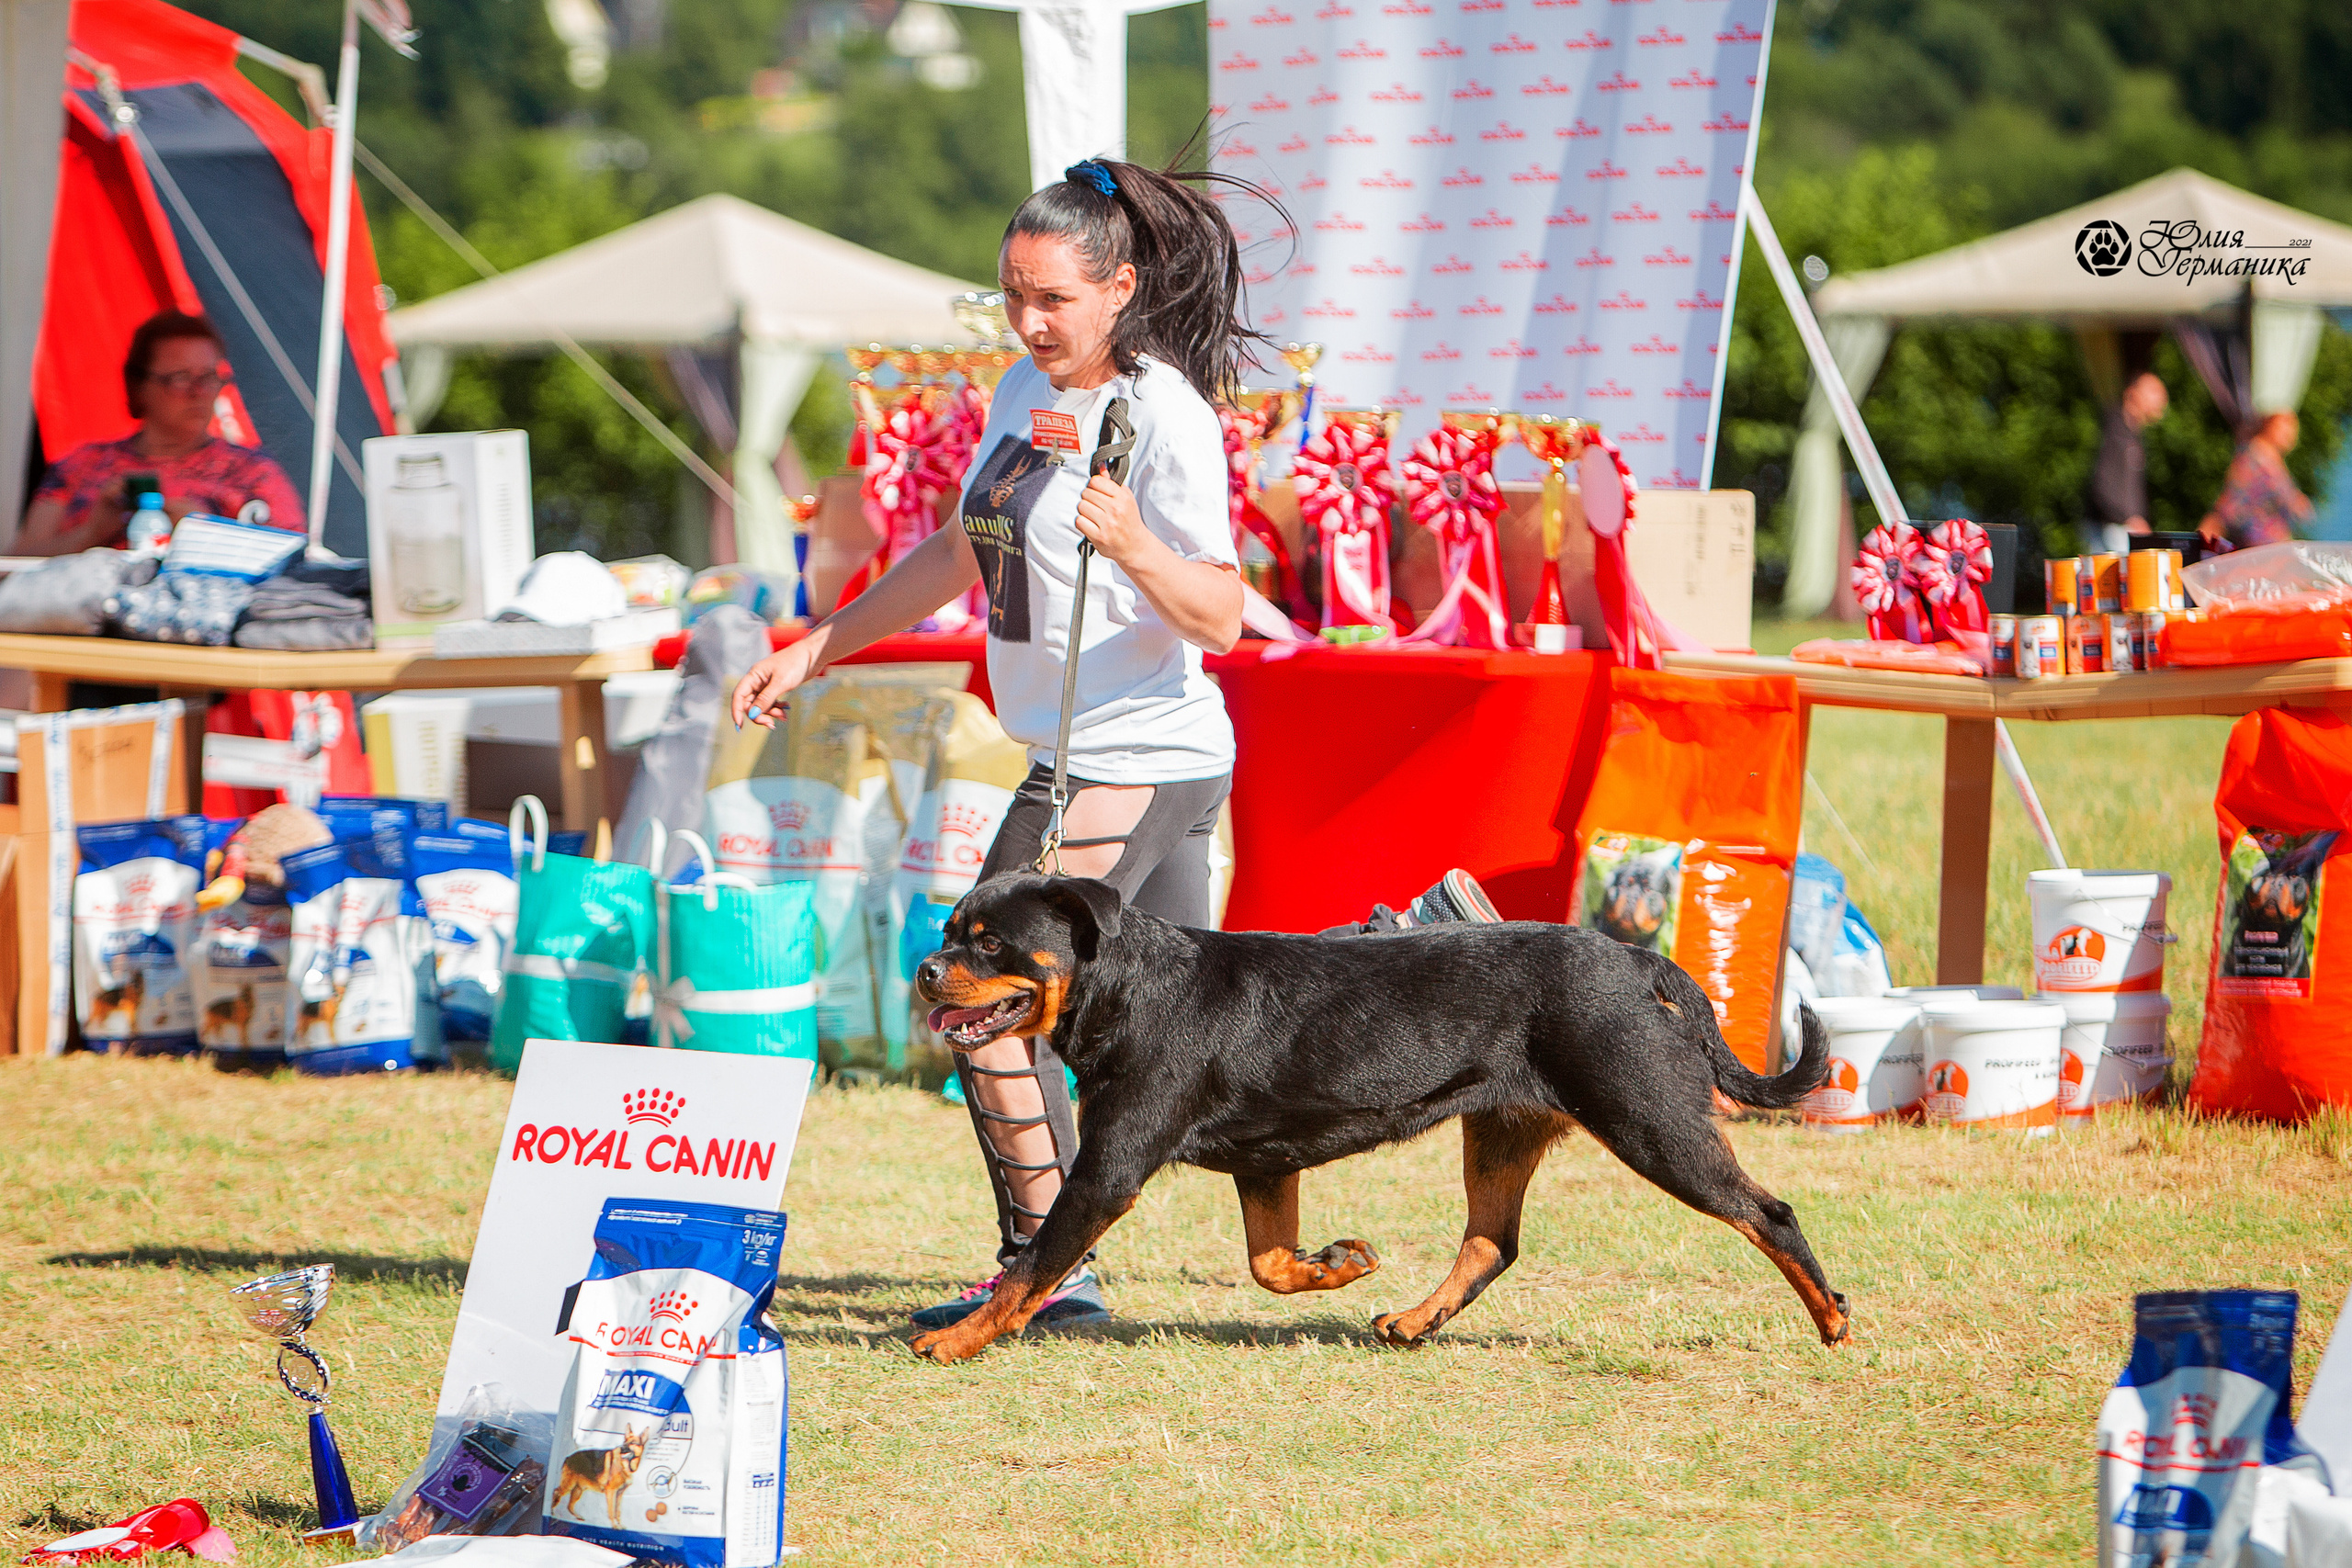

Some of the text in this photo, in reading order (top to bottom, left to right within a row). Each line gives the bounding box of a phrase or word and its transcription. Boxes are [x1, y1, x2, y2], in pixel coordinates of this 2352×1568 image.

[1035, 415, 1076, 430] ТРАПЕЗА
[2106, 1043, 2154, 1055] ROFIFEED
[512, 1122, 776, 1181] ROYAL CANIN
[741, 1229, 752, 1244] 3
[597, 1374, 657, 1400] MAXI
